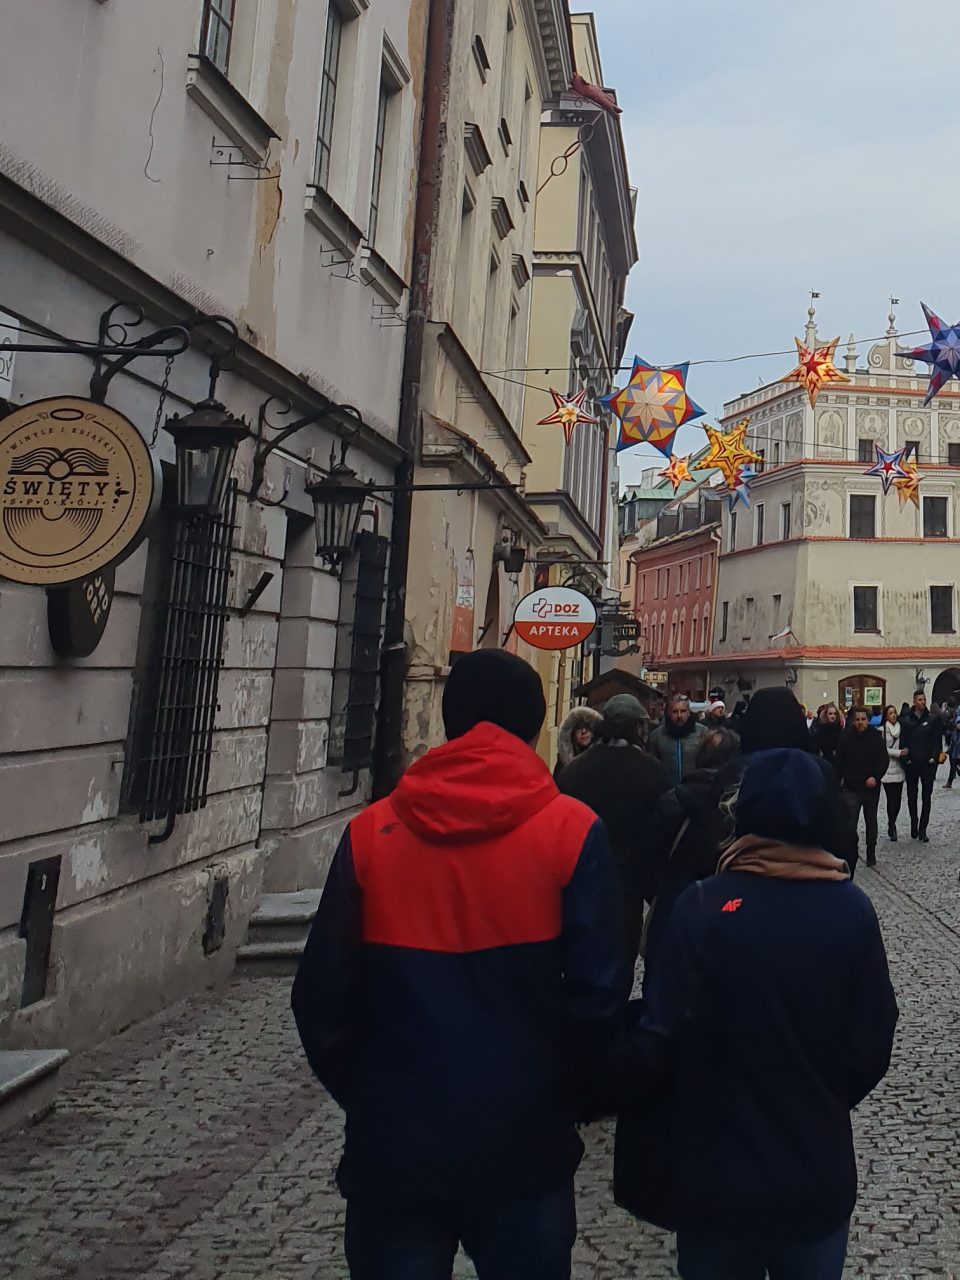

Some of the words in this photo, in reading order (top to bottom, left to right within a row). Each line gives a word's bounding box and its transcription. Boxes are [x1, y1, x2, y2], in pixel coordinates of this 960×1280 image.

[3, 477, 110, 500] ŚWIĘTY
[554, 604, 580, 613] DOZ
[529, 626, 579, 636] APTEKA
